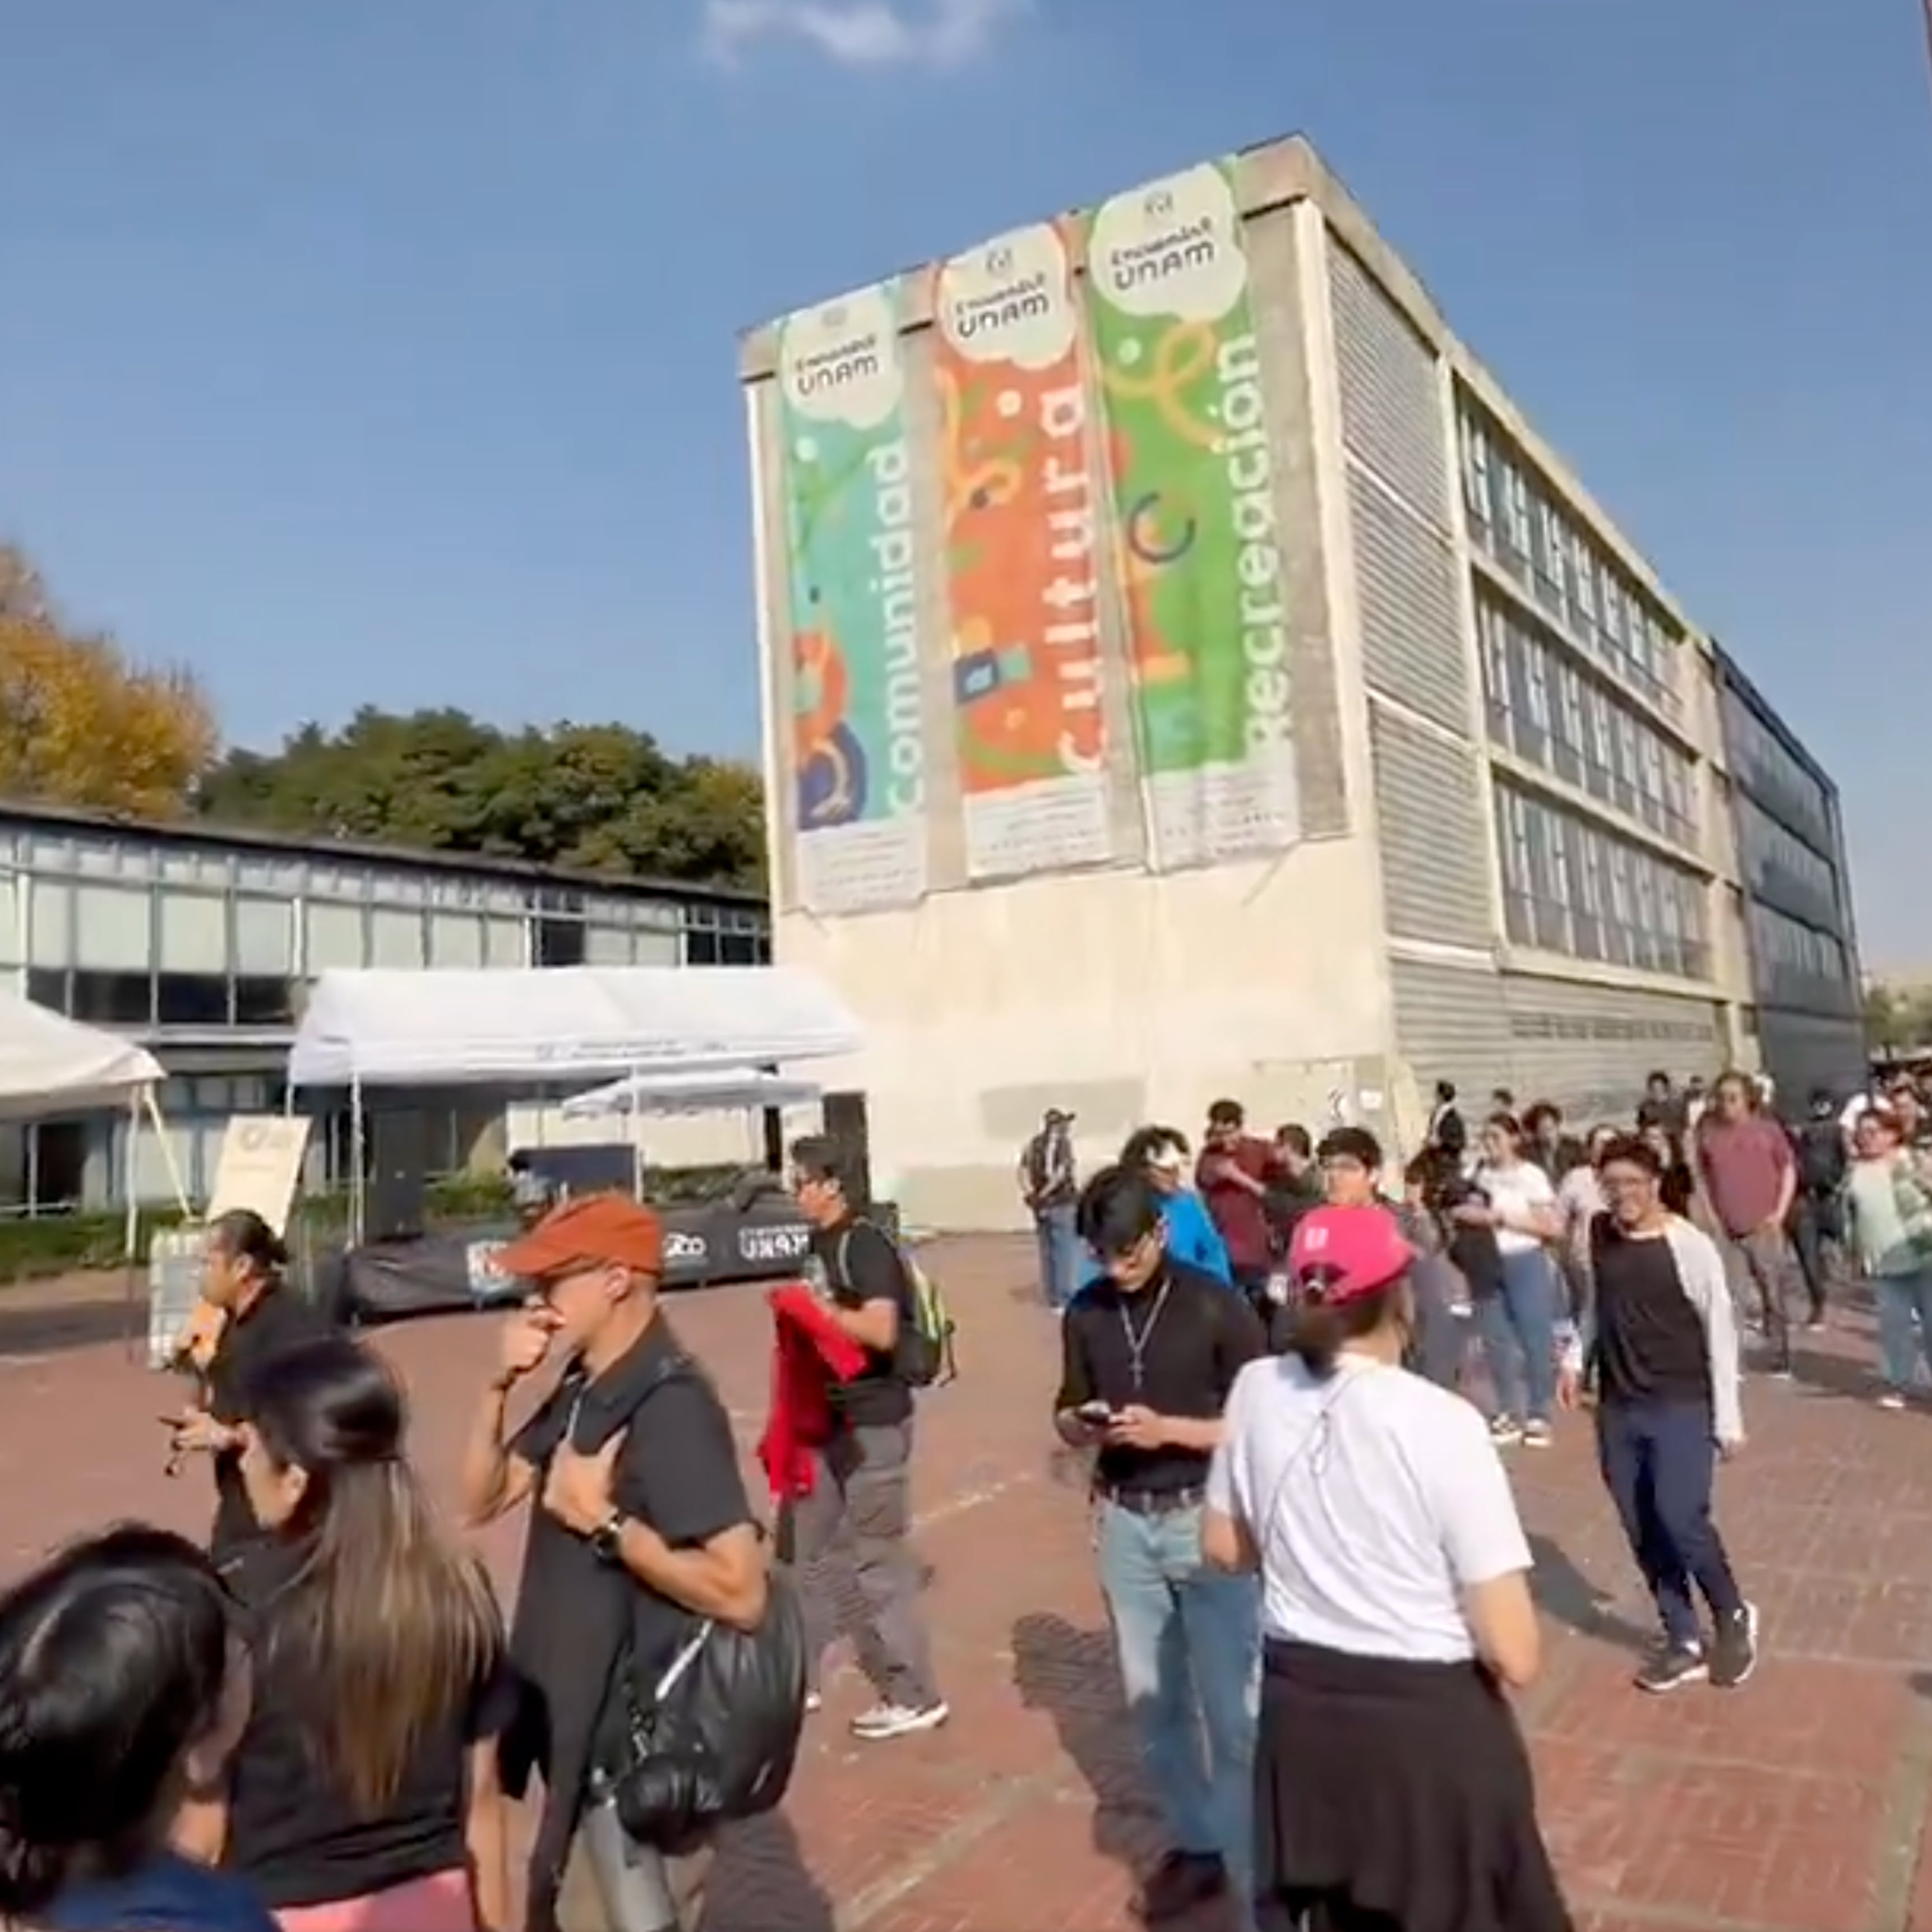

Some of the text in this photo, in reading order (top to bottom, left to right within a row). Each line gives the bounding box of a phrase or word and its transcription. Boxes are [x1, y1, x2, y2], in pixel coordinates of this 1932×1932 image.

[1115, 241, 1214, 290] UNAM
[959, 294, 1048, 338] UNAM
[798, 355, 879, 395] UNAM
[1040, 385, 1107, 773] cultura
[867, 440, 923, 813] comunidad
